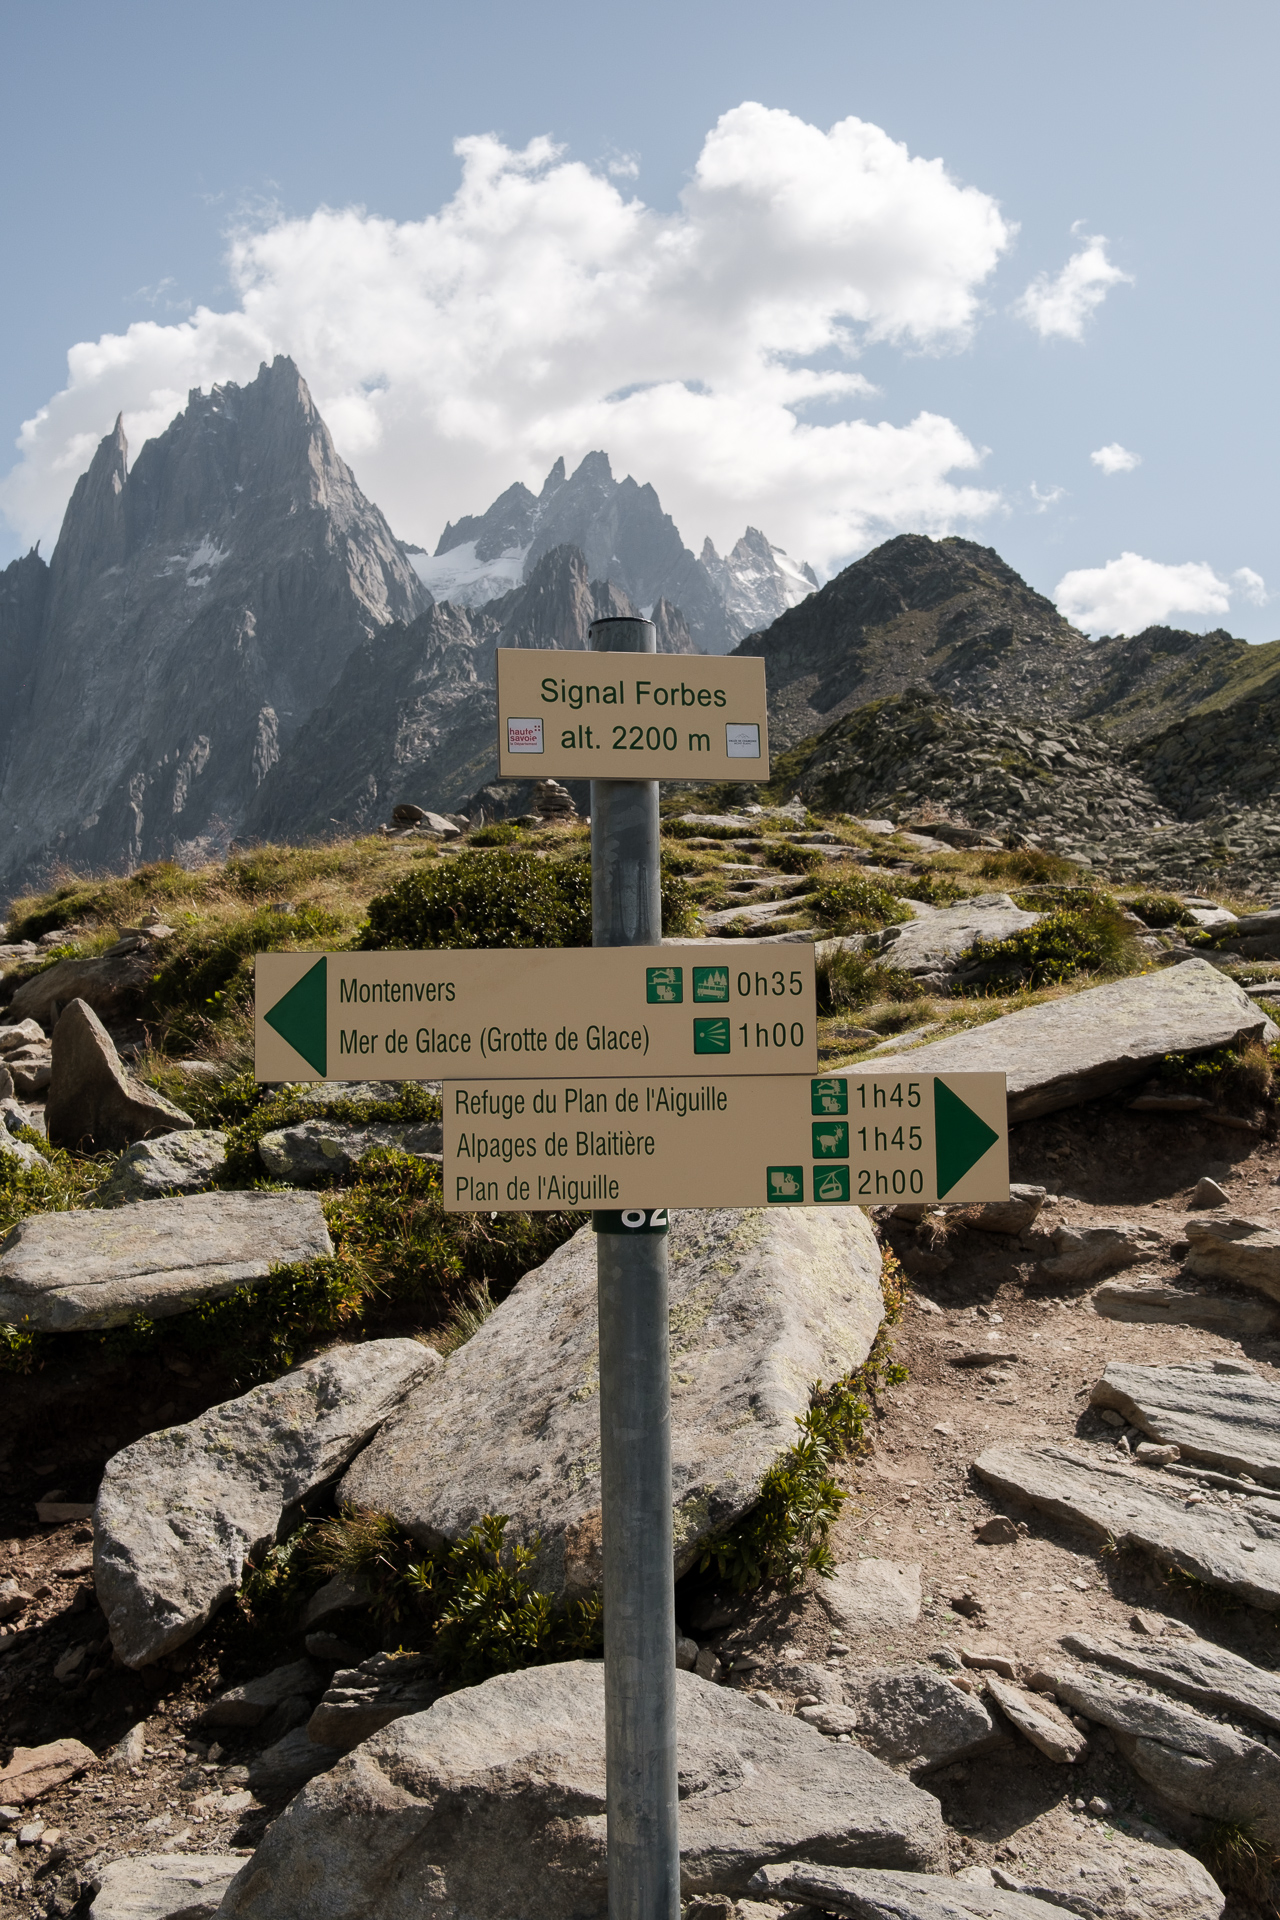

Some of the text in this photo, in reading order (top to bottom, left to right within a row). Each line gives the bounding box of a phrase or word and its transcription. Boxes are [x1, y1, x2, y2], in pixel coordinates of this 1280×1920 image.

[540, 677, 727, 710] Signal Forbes
[509, 727, 534, 736] haute
[560, 724, 711, 752] alt. 2200 m
[339, 978, 456, 1004] Montenvers
[737, 970, 803, 997] 0h35
[339, 1024, 650, 1059] Mer de Glace (Grotte de Glace)
[738, 1021, 804, 1048] 1h00
[455, 1085, 728, 1120] Refuge du Plan de l'Aiguille
[856, 1082, 922, 1109] 1h45
[456, 1130, 655, 1164] Alpages de Blaitière
[857, 1125, 923, 1152] 1h45
[456, 1174, 620, 1206] Plan de l'Aiguille
[857, 1168, 924, 1195] 2h00
